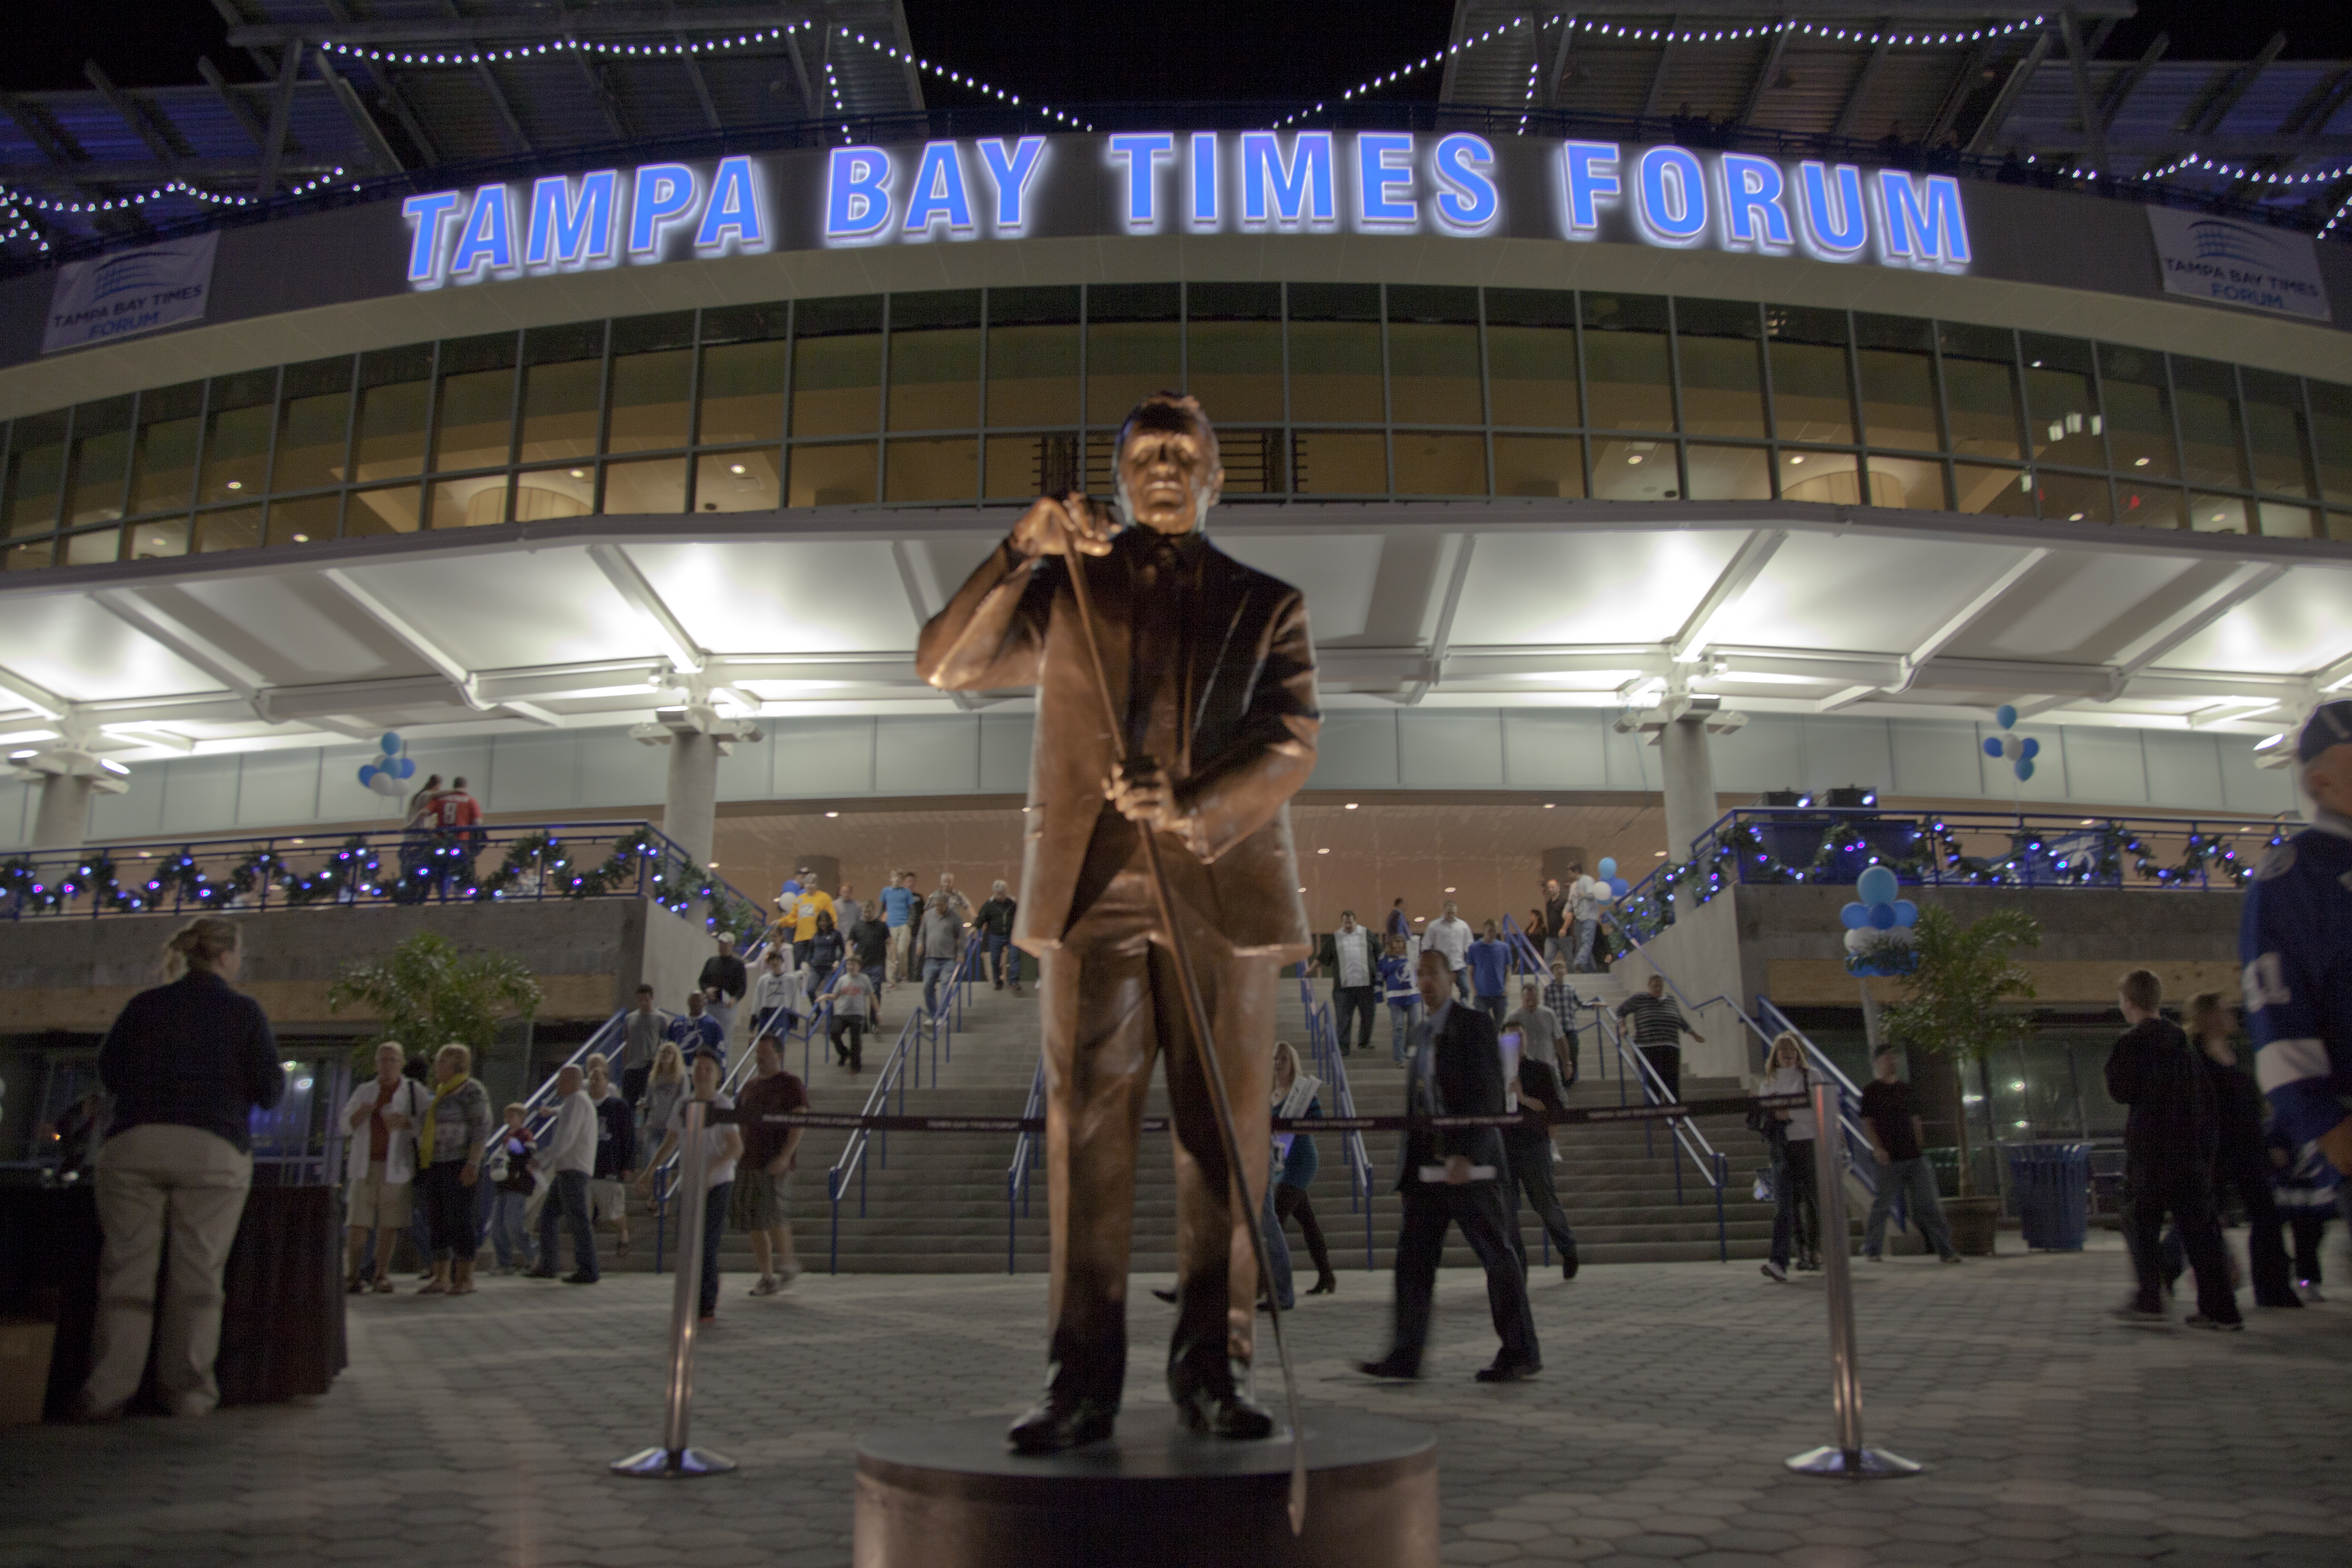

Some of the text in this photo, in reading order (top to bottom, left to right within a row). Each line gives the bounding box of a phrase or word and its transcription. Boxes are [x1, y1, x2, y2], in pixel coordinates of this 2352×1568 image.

[402, 131, 1971, 282] TAMPA BAY TIMES FORUM
[2164, 258, 2319, 297] TAMPA BAY TIMES
[2211, 283, 2285, 309] FORUM
[54, 284, 203, 328] TAMPA BAY TIMES
[88, 311, 160, 338] FORUM
